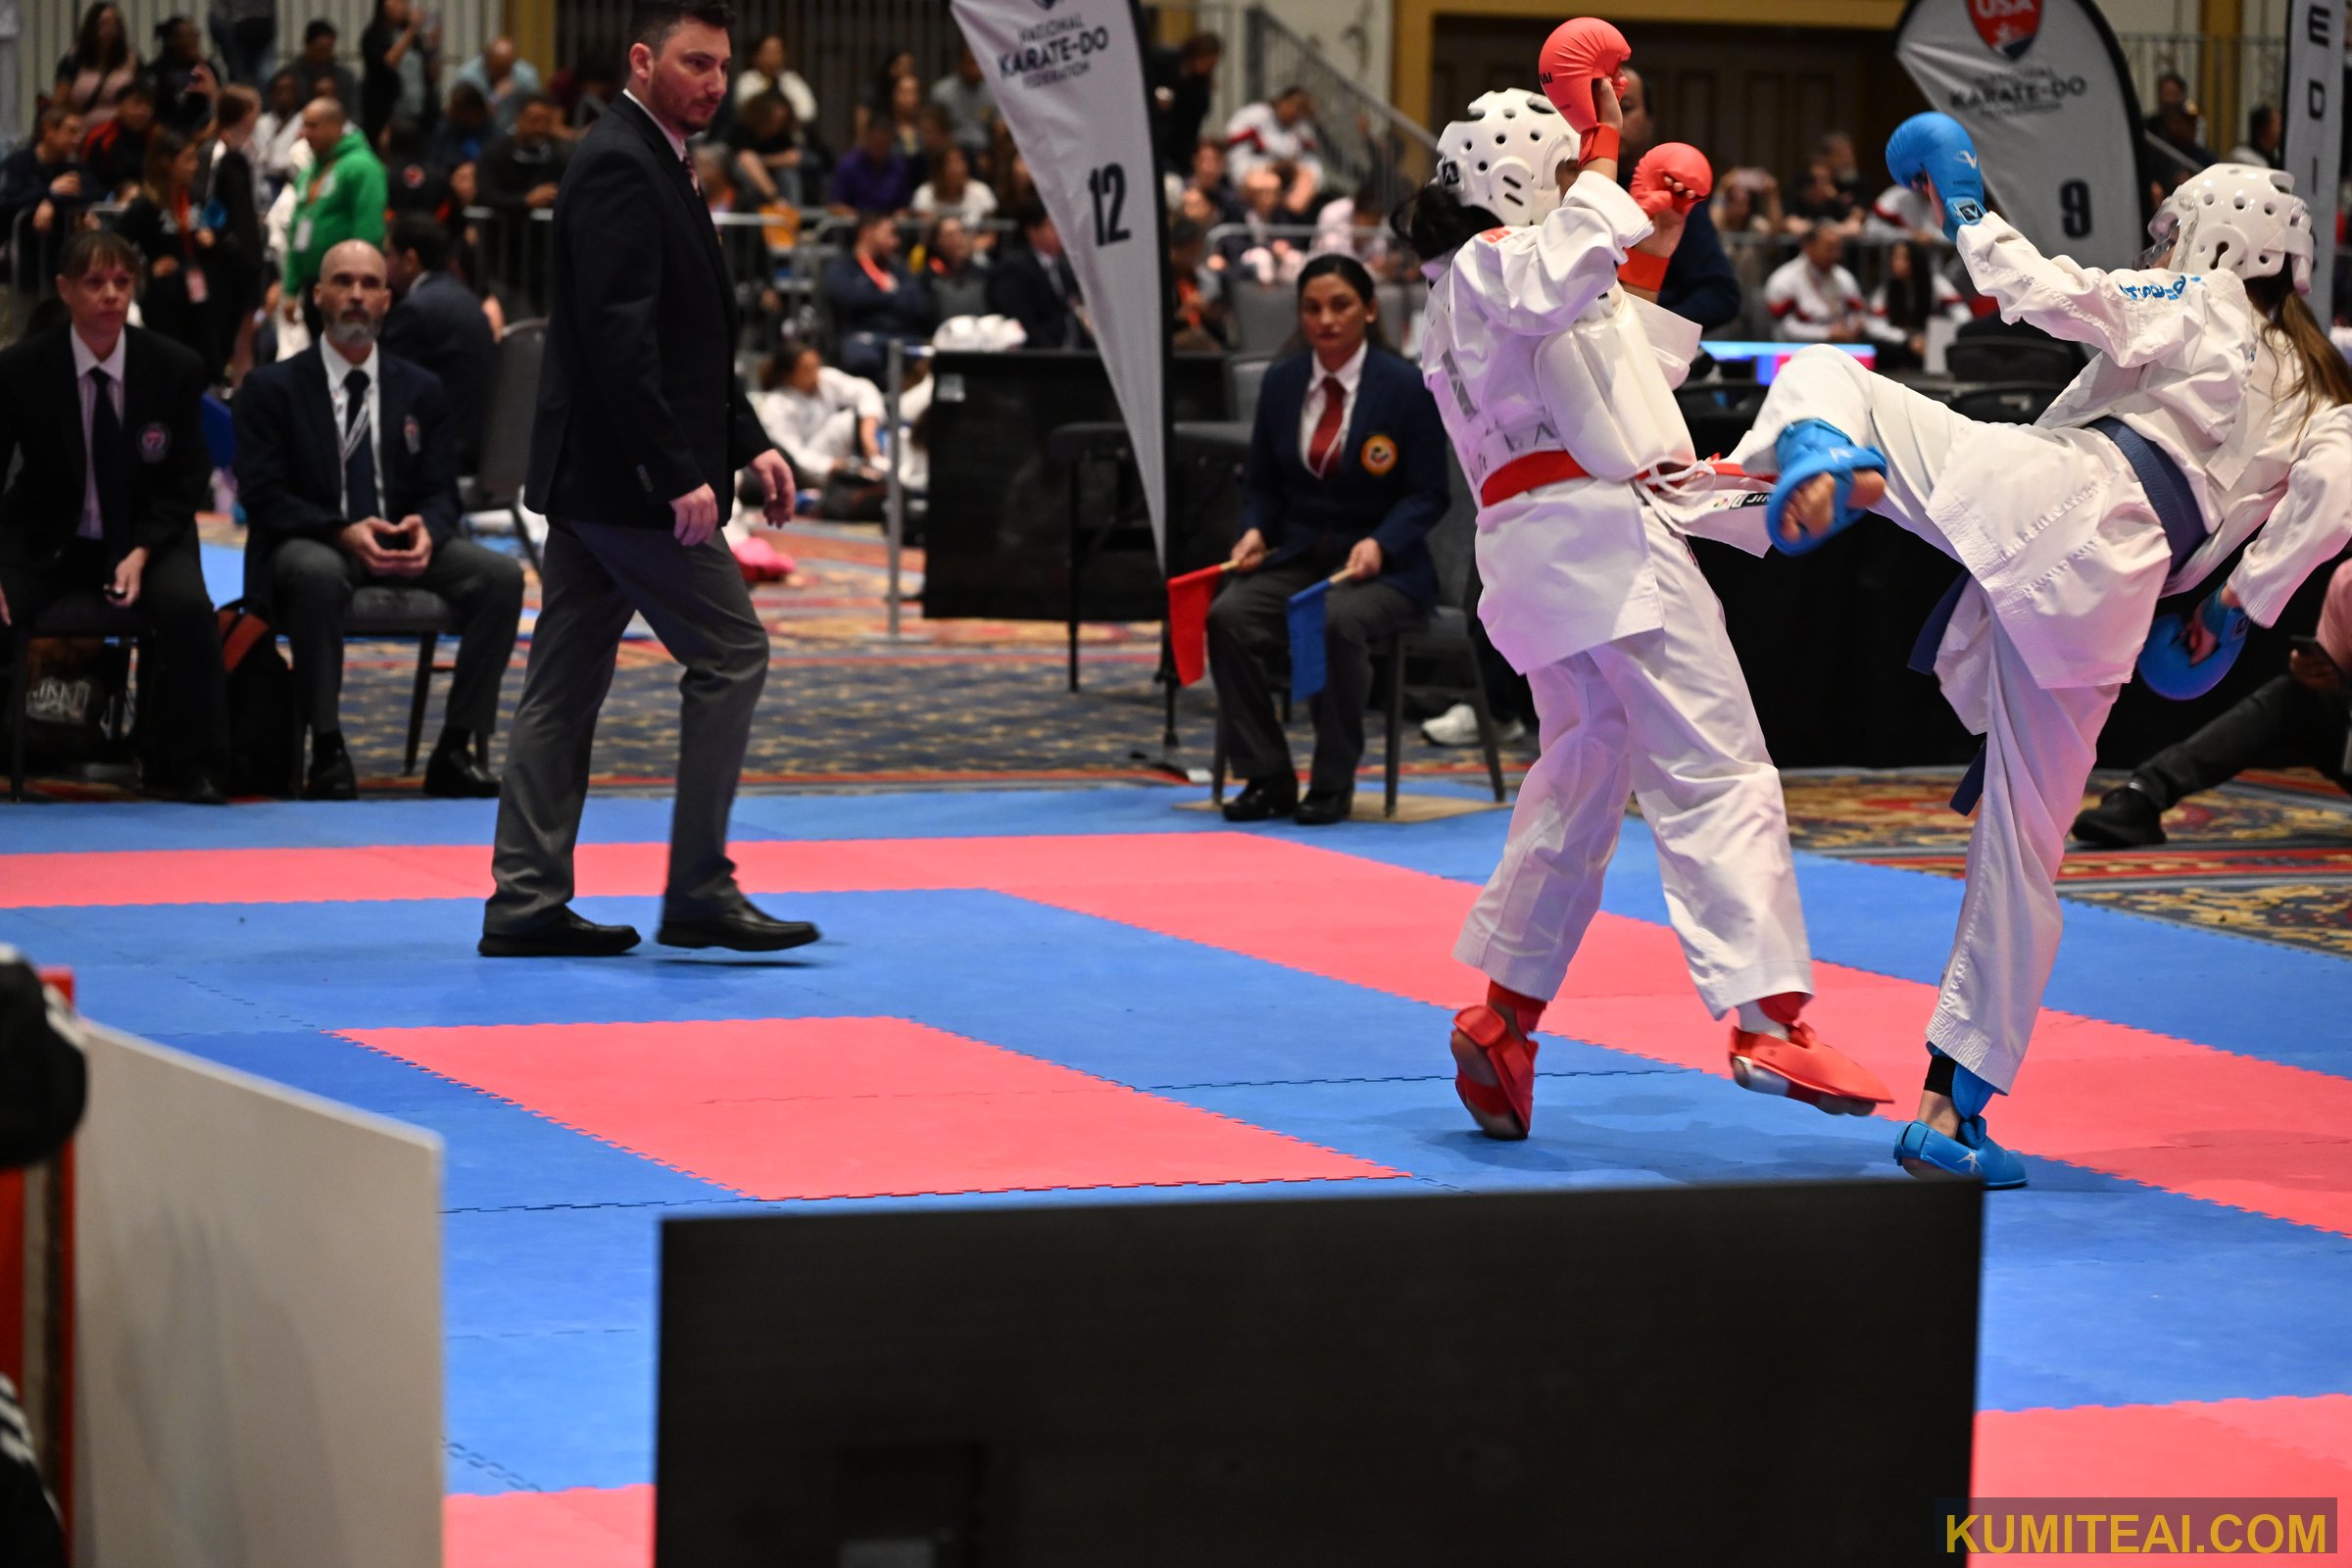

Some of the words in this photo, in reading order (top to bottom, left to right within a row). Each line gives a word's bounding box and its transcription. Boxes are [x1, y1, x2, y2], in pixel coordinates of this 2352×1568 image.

[998, 25, 1109, 78] KARATE-DO
[1088, 162, 1131, 248] 12
[2060, 177, 2092, 239] 9
